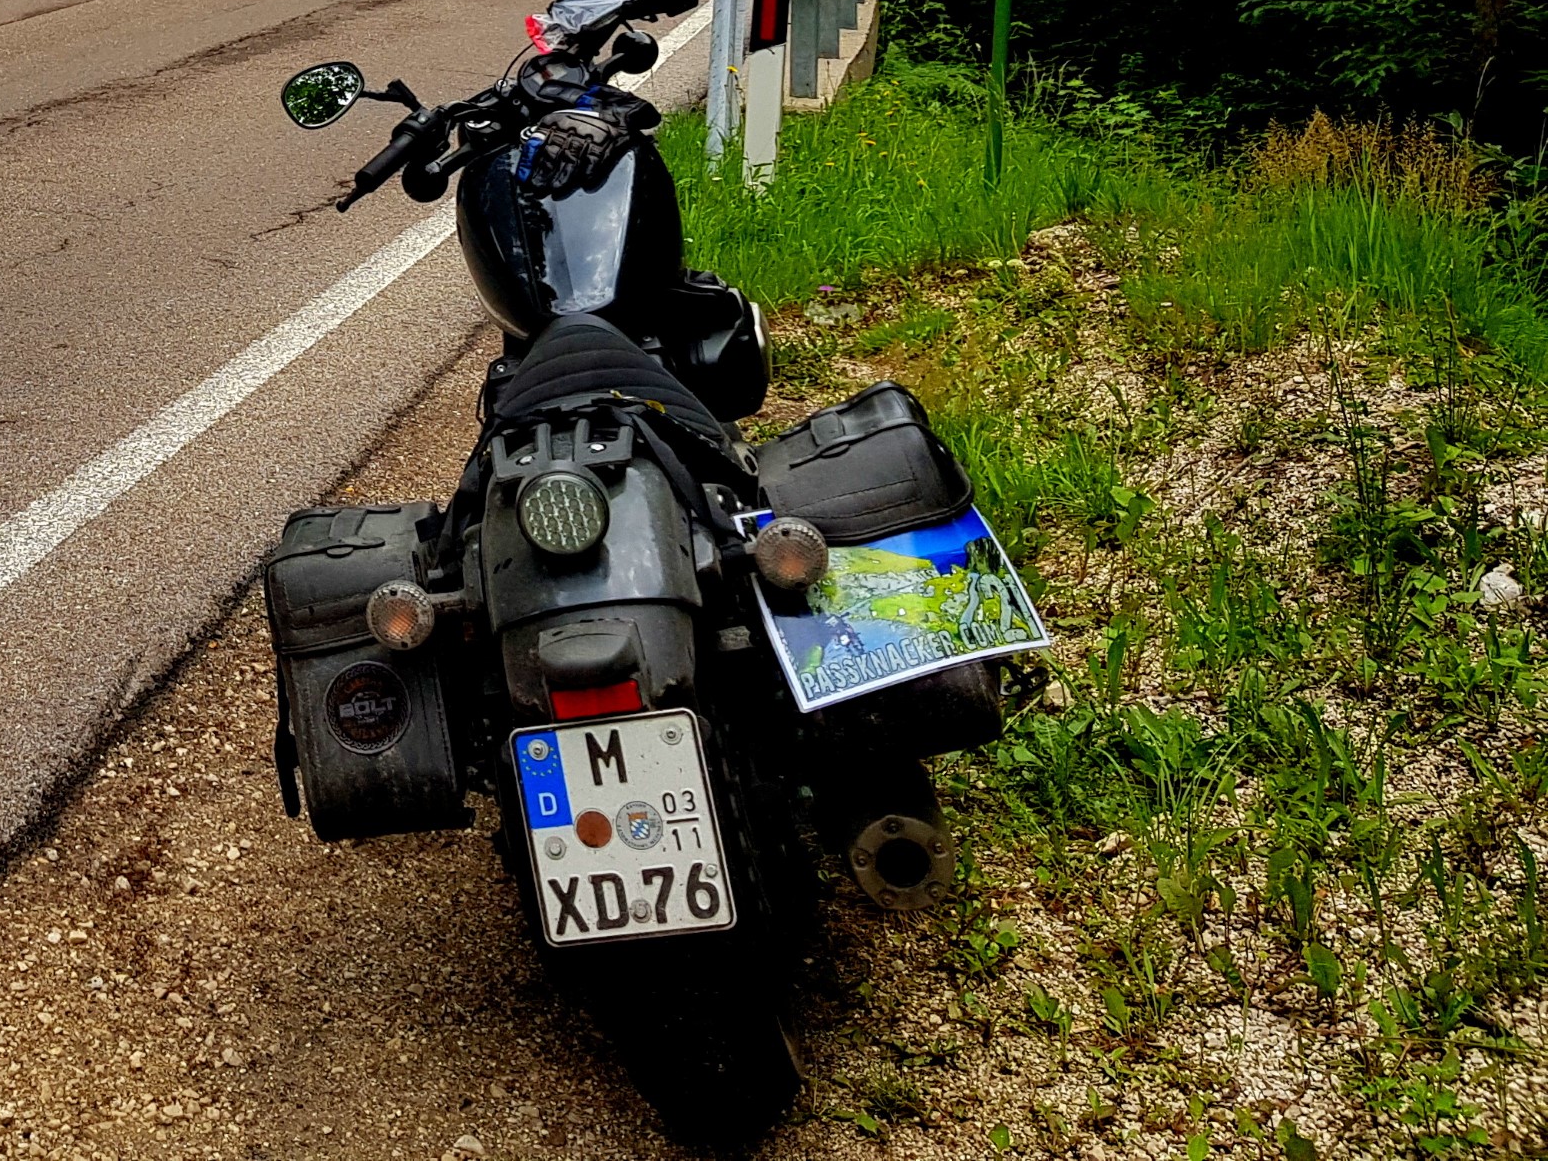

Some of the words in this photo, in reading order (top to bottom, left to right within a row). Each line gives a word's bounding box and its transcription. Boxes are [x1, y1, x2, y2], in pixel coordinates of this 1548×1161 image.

[585, 728, 628, 786] M
[538, 792, 558, 816] D
[662, 790, 696, 815] 03
